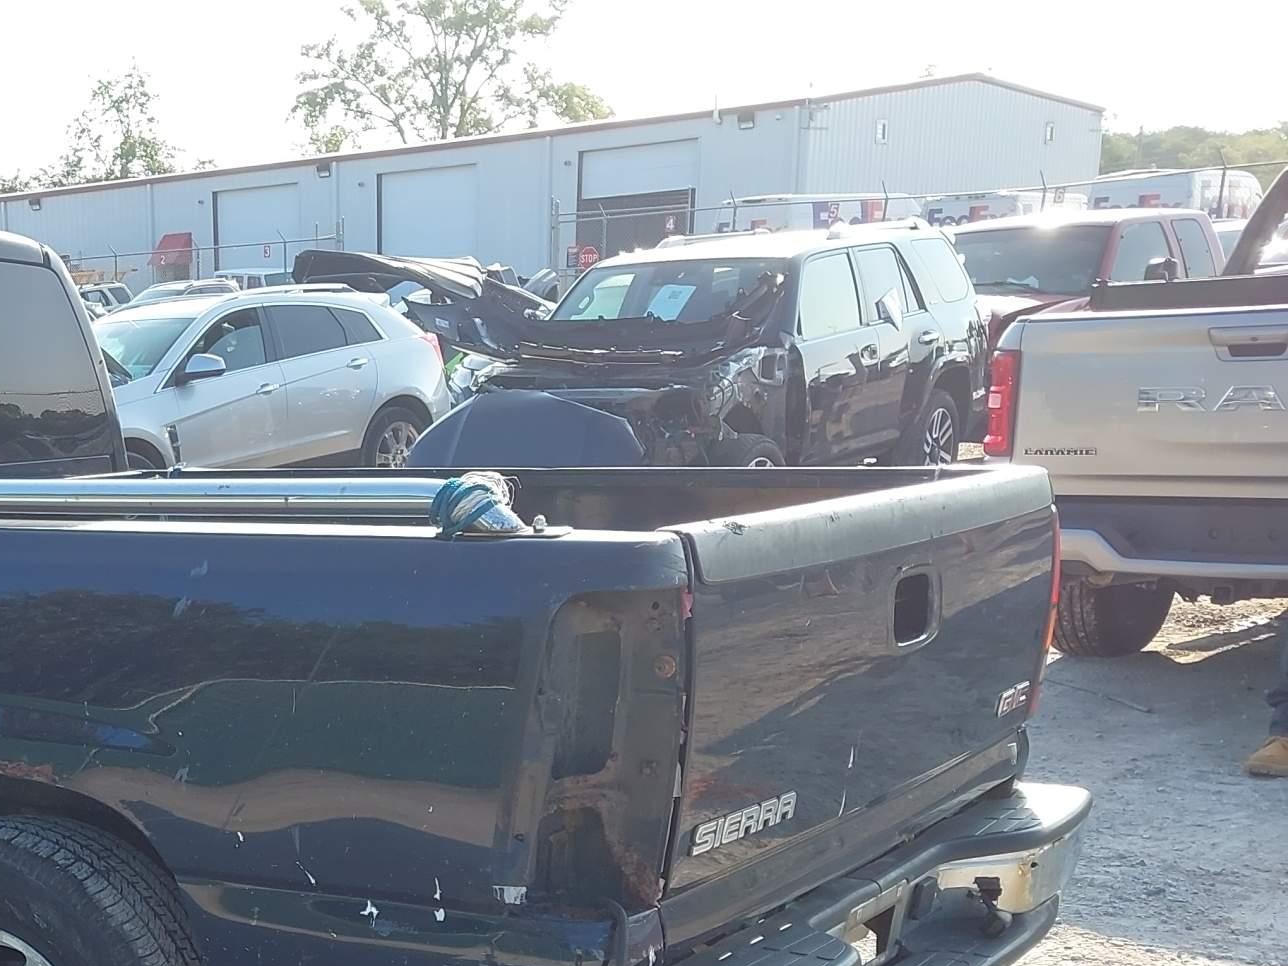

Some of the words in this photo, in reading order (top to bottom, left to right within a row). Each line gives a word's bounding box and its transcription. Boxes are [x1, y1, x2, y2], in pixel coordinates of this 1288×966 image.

[829, 204, 839, 217] 5
[580, 254, 597, 263] STOP
[692, 790, 797, 857] SIERRA
